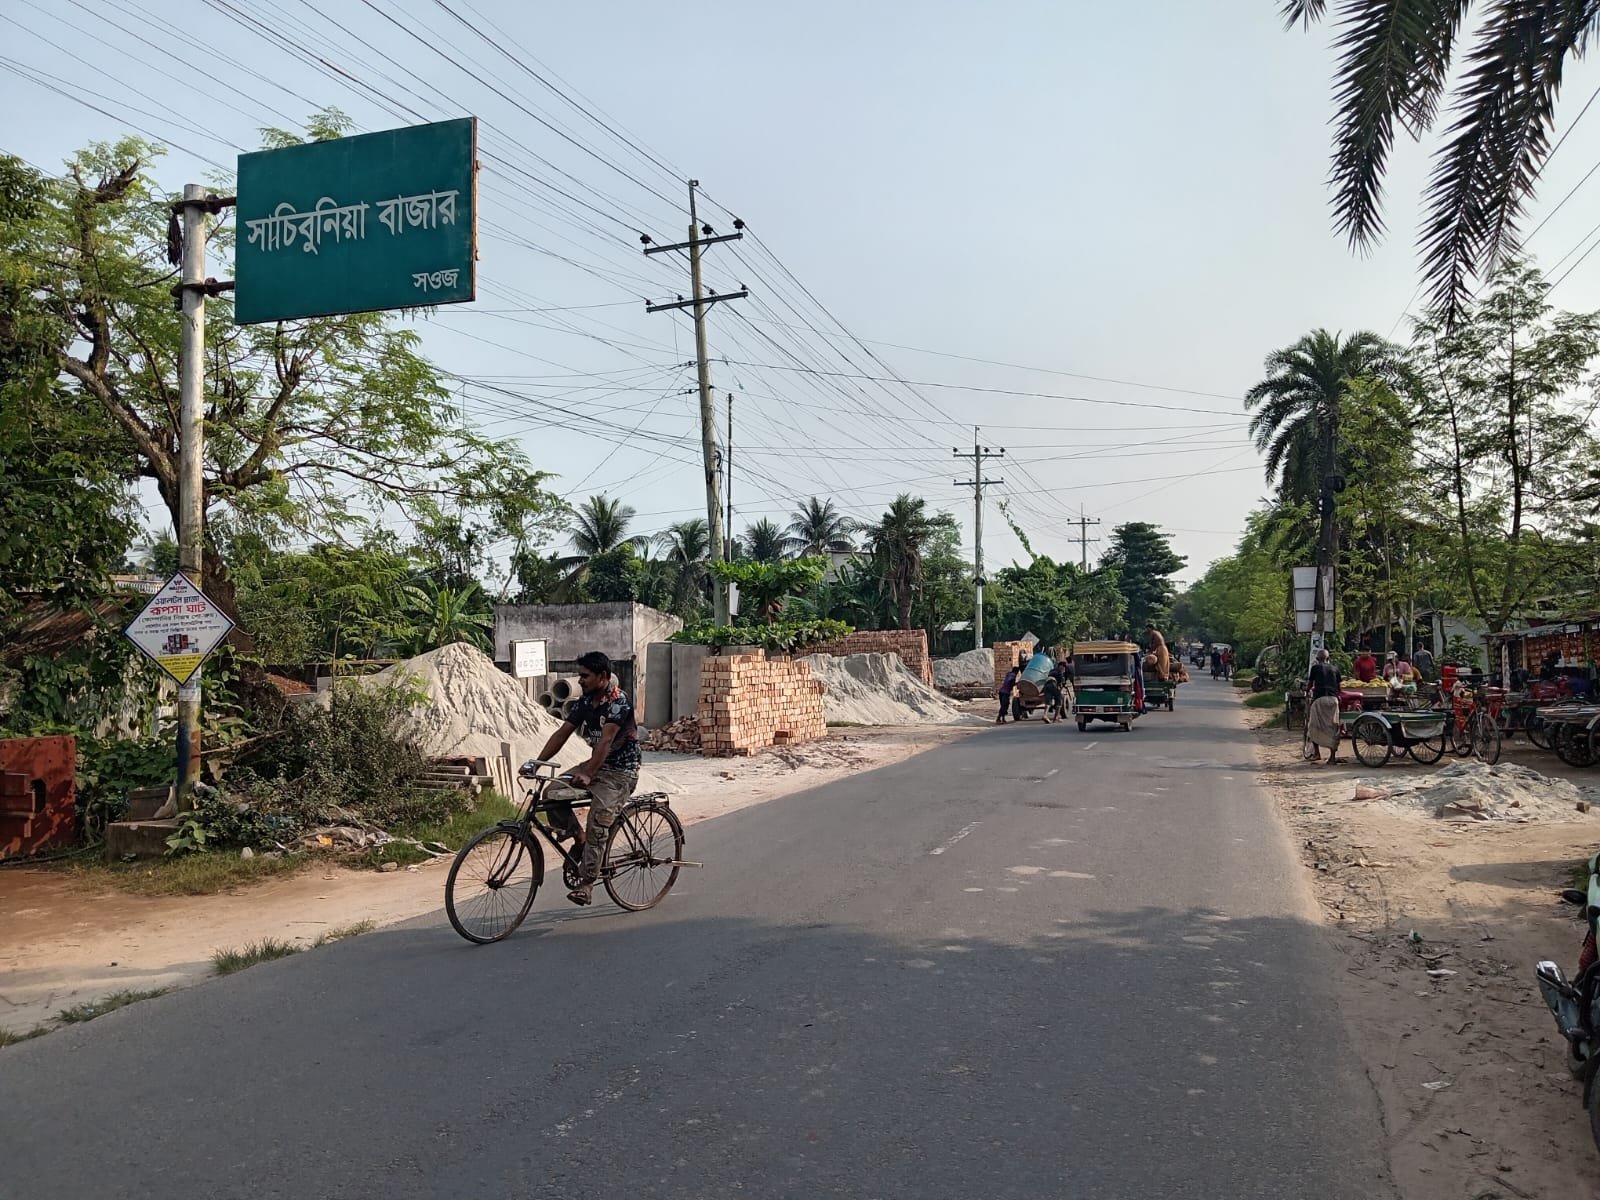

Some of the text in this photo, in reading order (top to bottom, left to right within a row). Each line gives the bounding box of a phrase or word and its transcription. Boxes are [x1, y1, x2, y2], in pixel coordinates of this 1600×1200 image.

[245, 190, 459, 255] সাচিবুনিয়া বাজার
[412, 269, 459, 292] সওজ
[150, 601, 206, 615] রূপসা ঘাট
